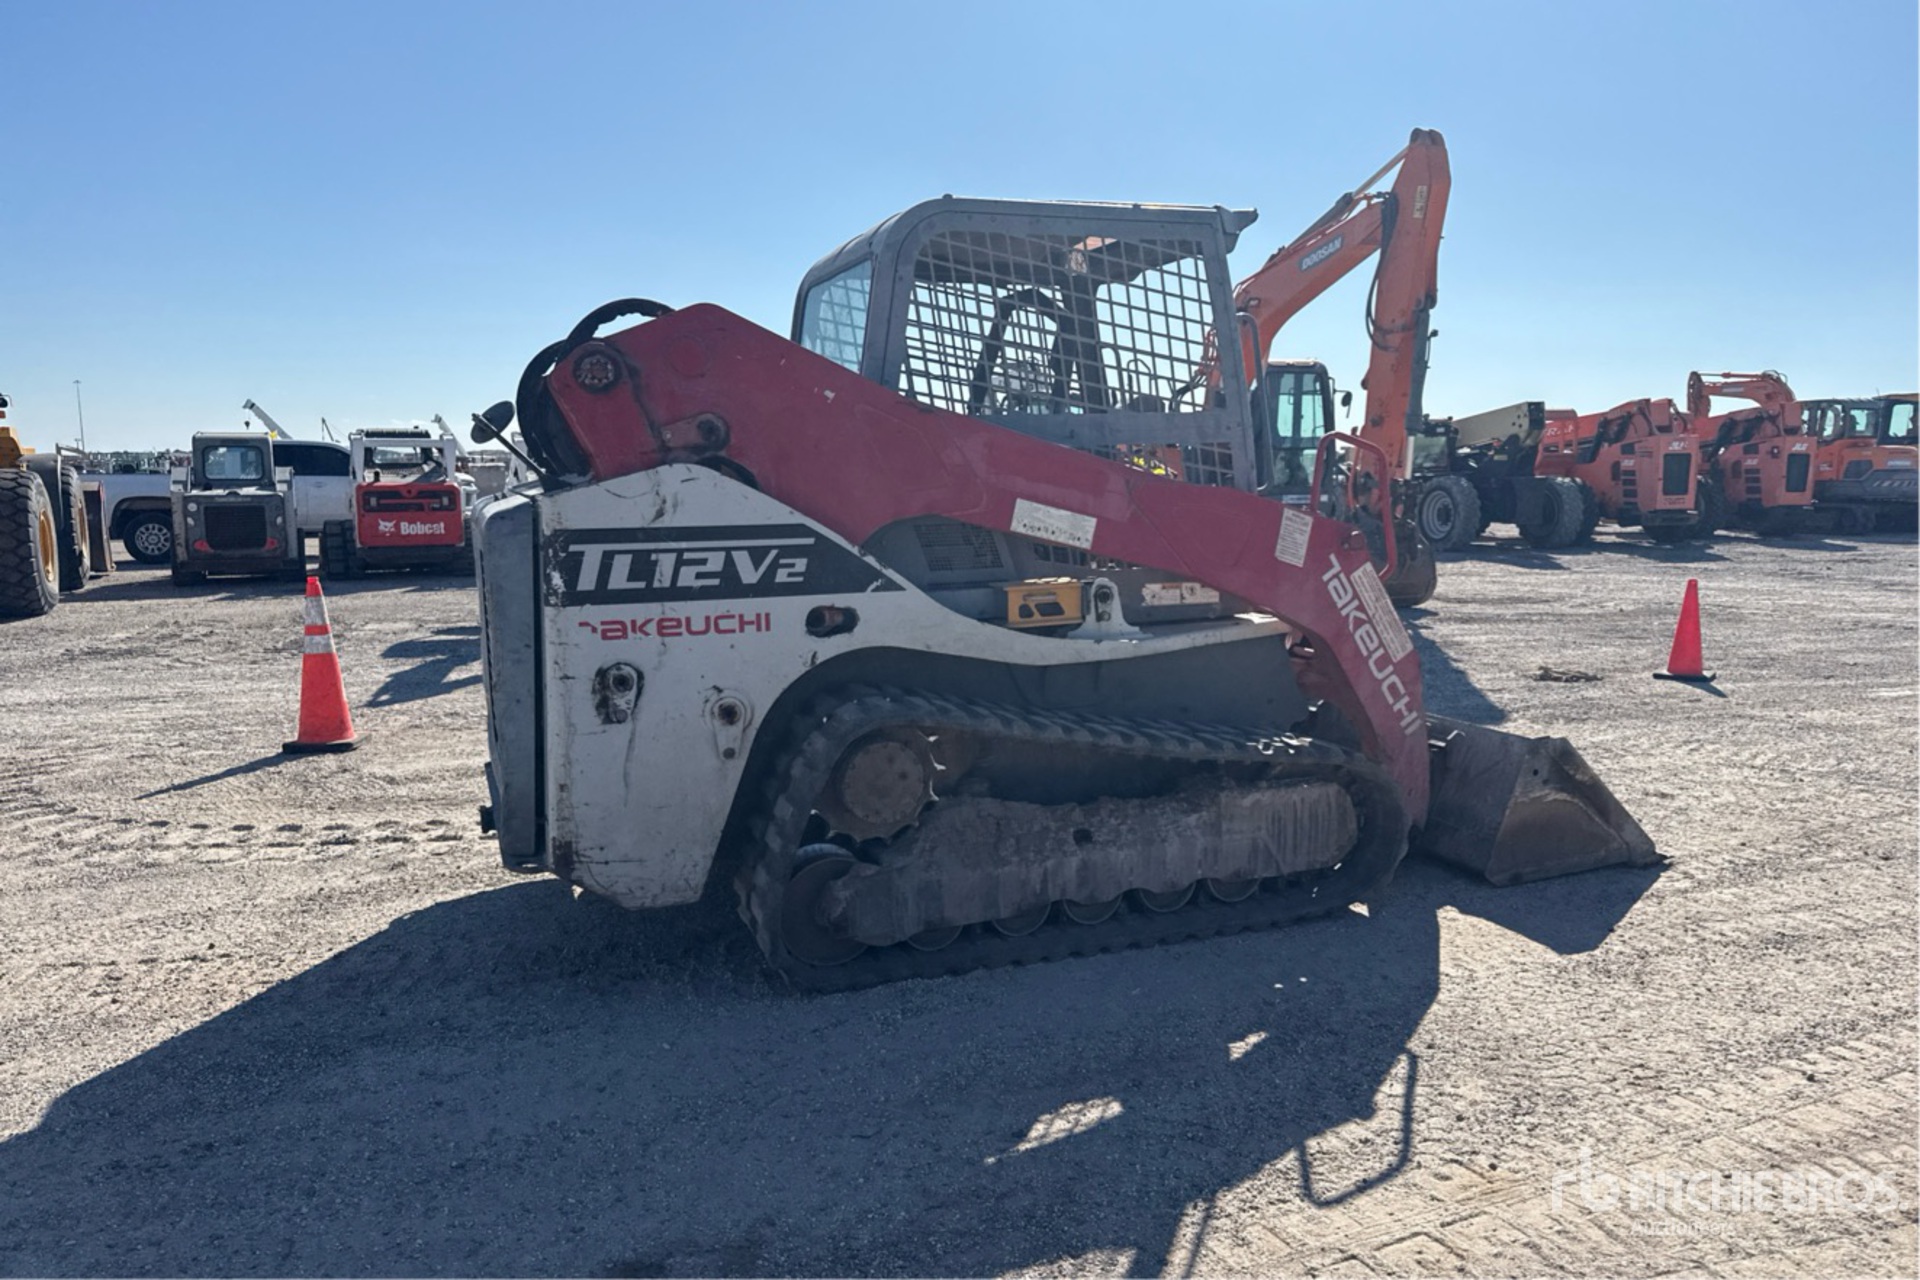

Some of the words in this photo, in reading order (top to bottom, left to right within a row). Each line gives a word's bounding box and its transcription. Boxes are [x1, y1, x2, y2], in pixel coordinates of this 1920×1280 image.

[1301, 236, 1342, 270] DOOSAN
[400, 521, 445, 535] Bobcat
[568, 537, 816, 591] TL12V2
